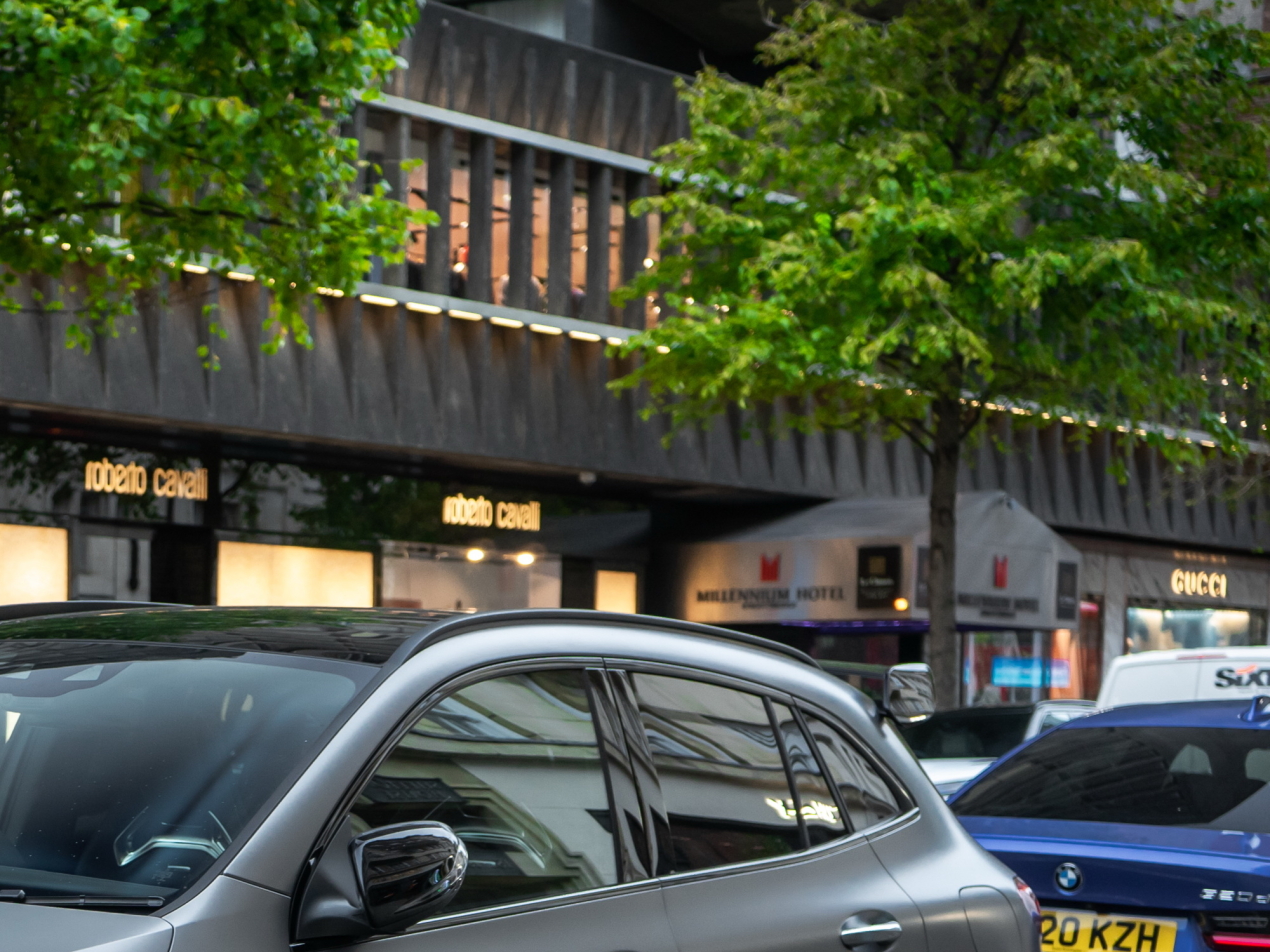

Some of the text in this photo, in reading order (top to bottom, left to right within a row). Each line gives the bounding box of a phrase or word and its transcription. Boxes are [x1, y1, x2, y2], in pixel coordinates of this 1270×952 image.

[84, 457, 208, 501] roberto cavalli
[442, 492, 541, 532] roberto cavalli
[696, 587, 790, 604] MILLENNIUM
[796, 585, 845, 601] HOTEL
[1171, 568, 1227, 598] GUCCI
